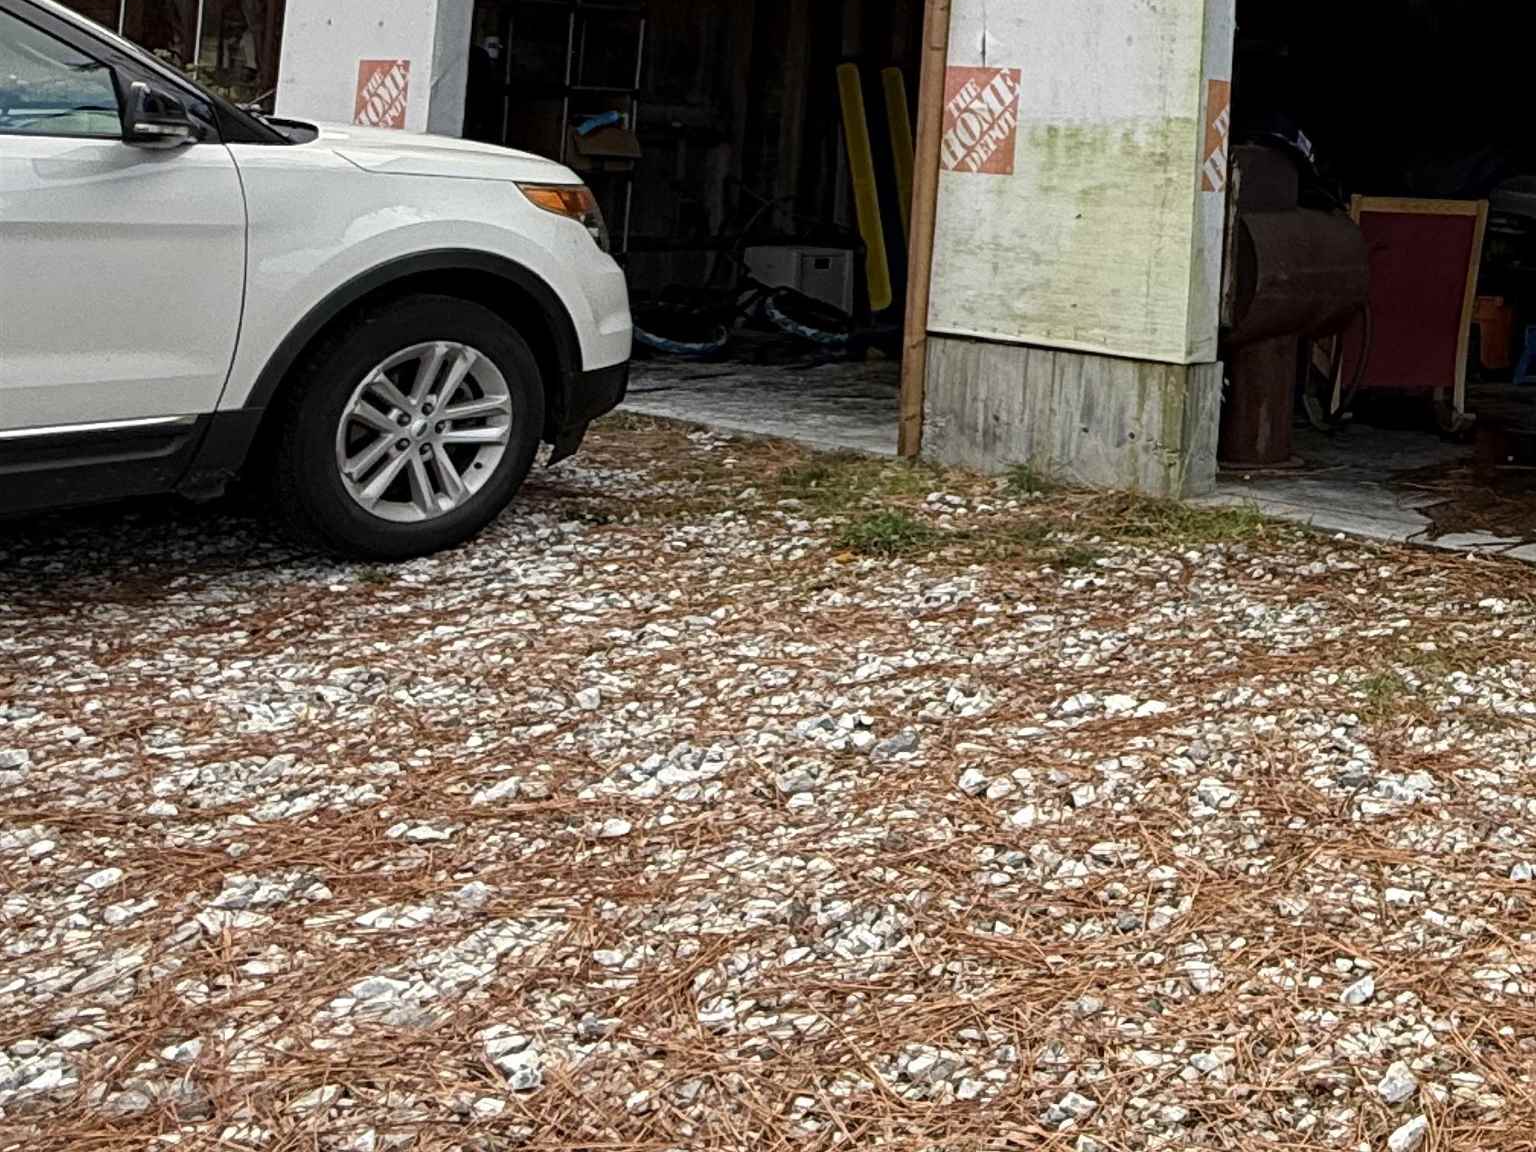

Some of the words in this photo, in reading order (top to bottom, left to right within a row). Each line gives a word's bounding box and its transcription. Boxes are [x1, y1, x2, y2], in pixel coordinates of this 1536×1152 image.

[941, 68, 1020, 170] HOME
[946, 78, 980, 118] THE
[964, 108, 1016, 172] DEPOT
